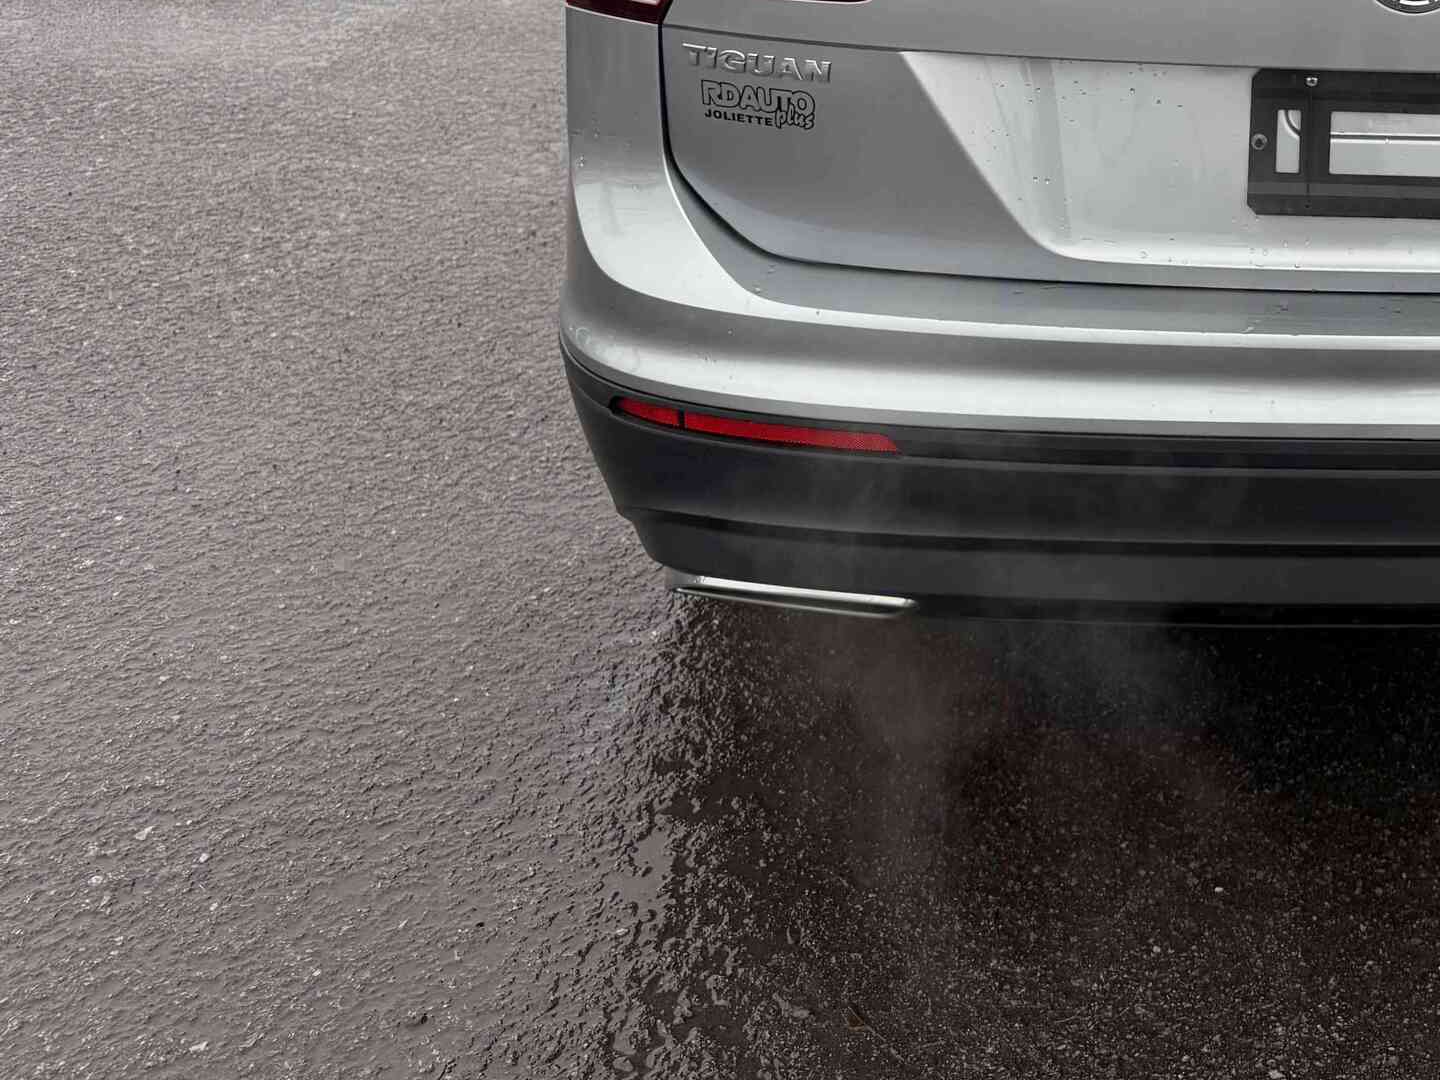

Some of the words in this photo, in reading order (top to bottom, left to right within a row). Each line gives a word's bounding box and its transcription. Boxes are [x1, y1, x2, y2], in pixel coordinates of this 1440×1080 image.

[682, 42, 832, 84] TIGUAN
[704, 108, 774, 127] JOLIETTE
[775, 103, 816, 130] plus
